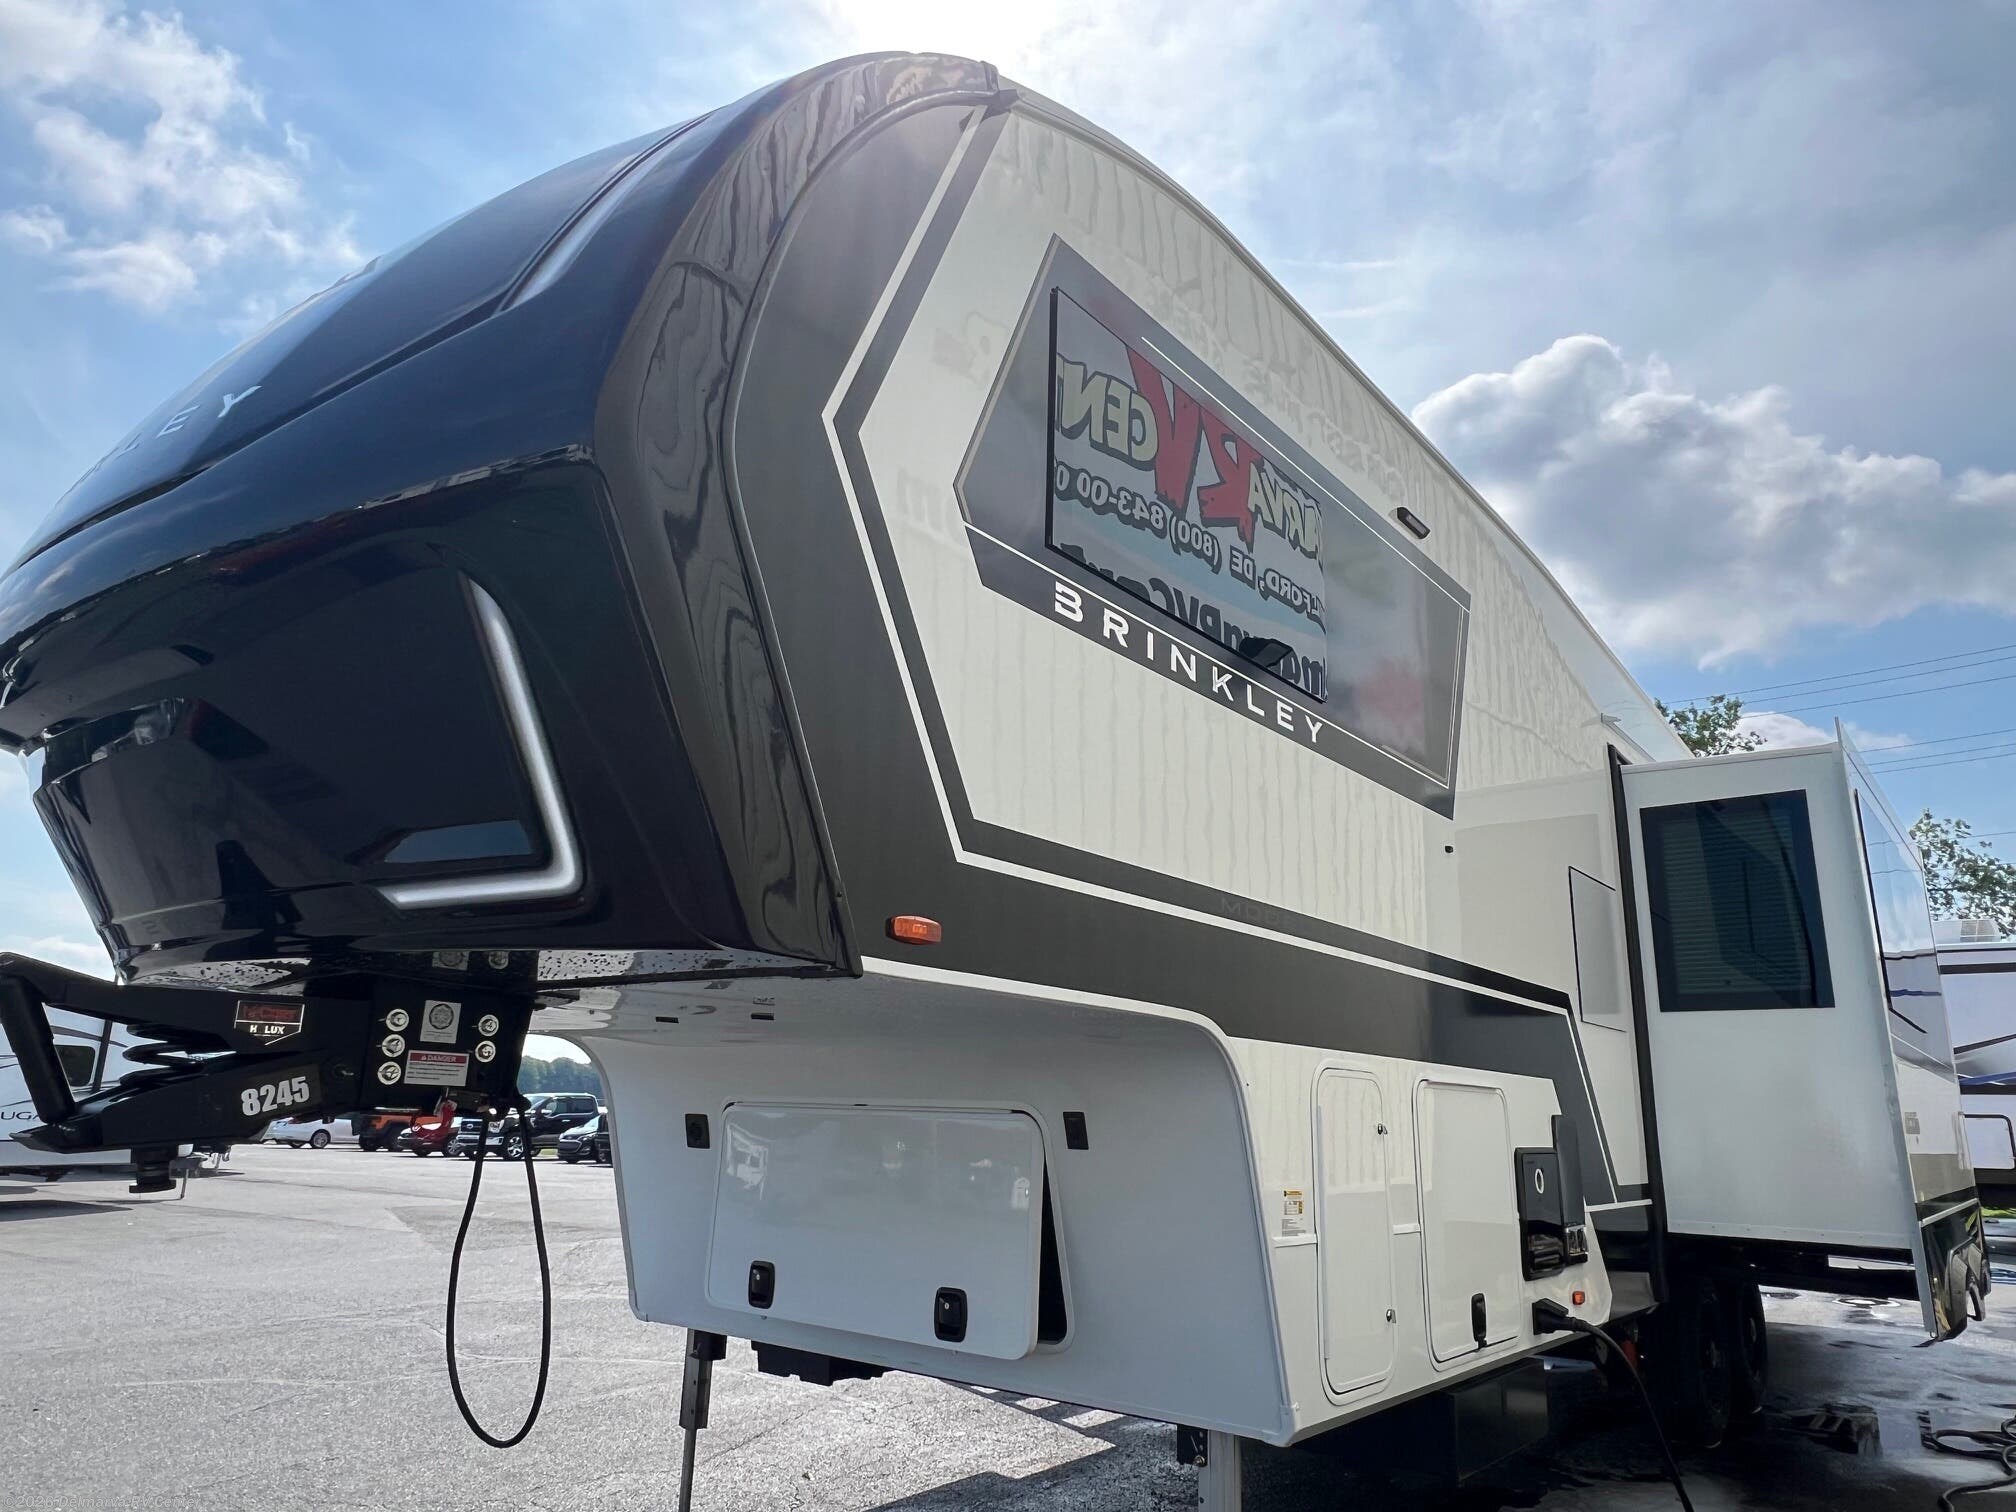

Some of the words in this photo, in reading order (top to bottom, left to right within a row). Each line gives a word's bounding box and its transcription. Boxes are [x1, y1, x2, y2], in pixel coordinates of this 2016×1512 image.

[1054, 581, 1322, 742] BRINKLEY
[427, 1054, 457, 1063] DANGER
[241, 1076, 310, 1116] 8245
